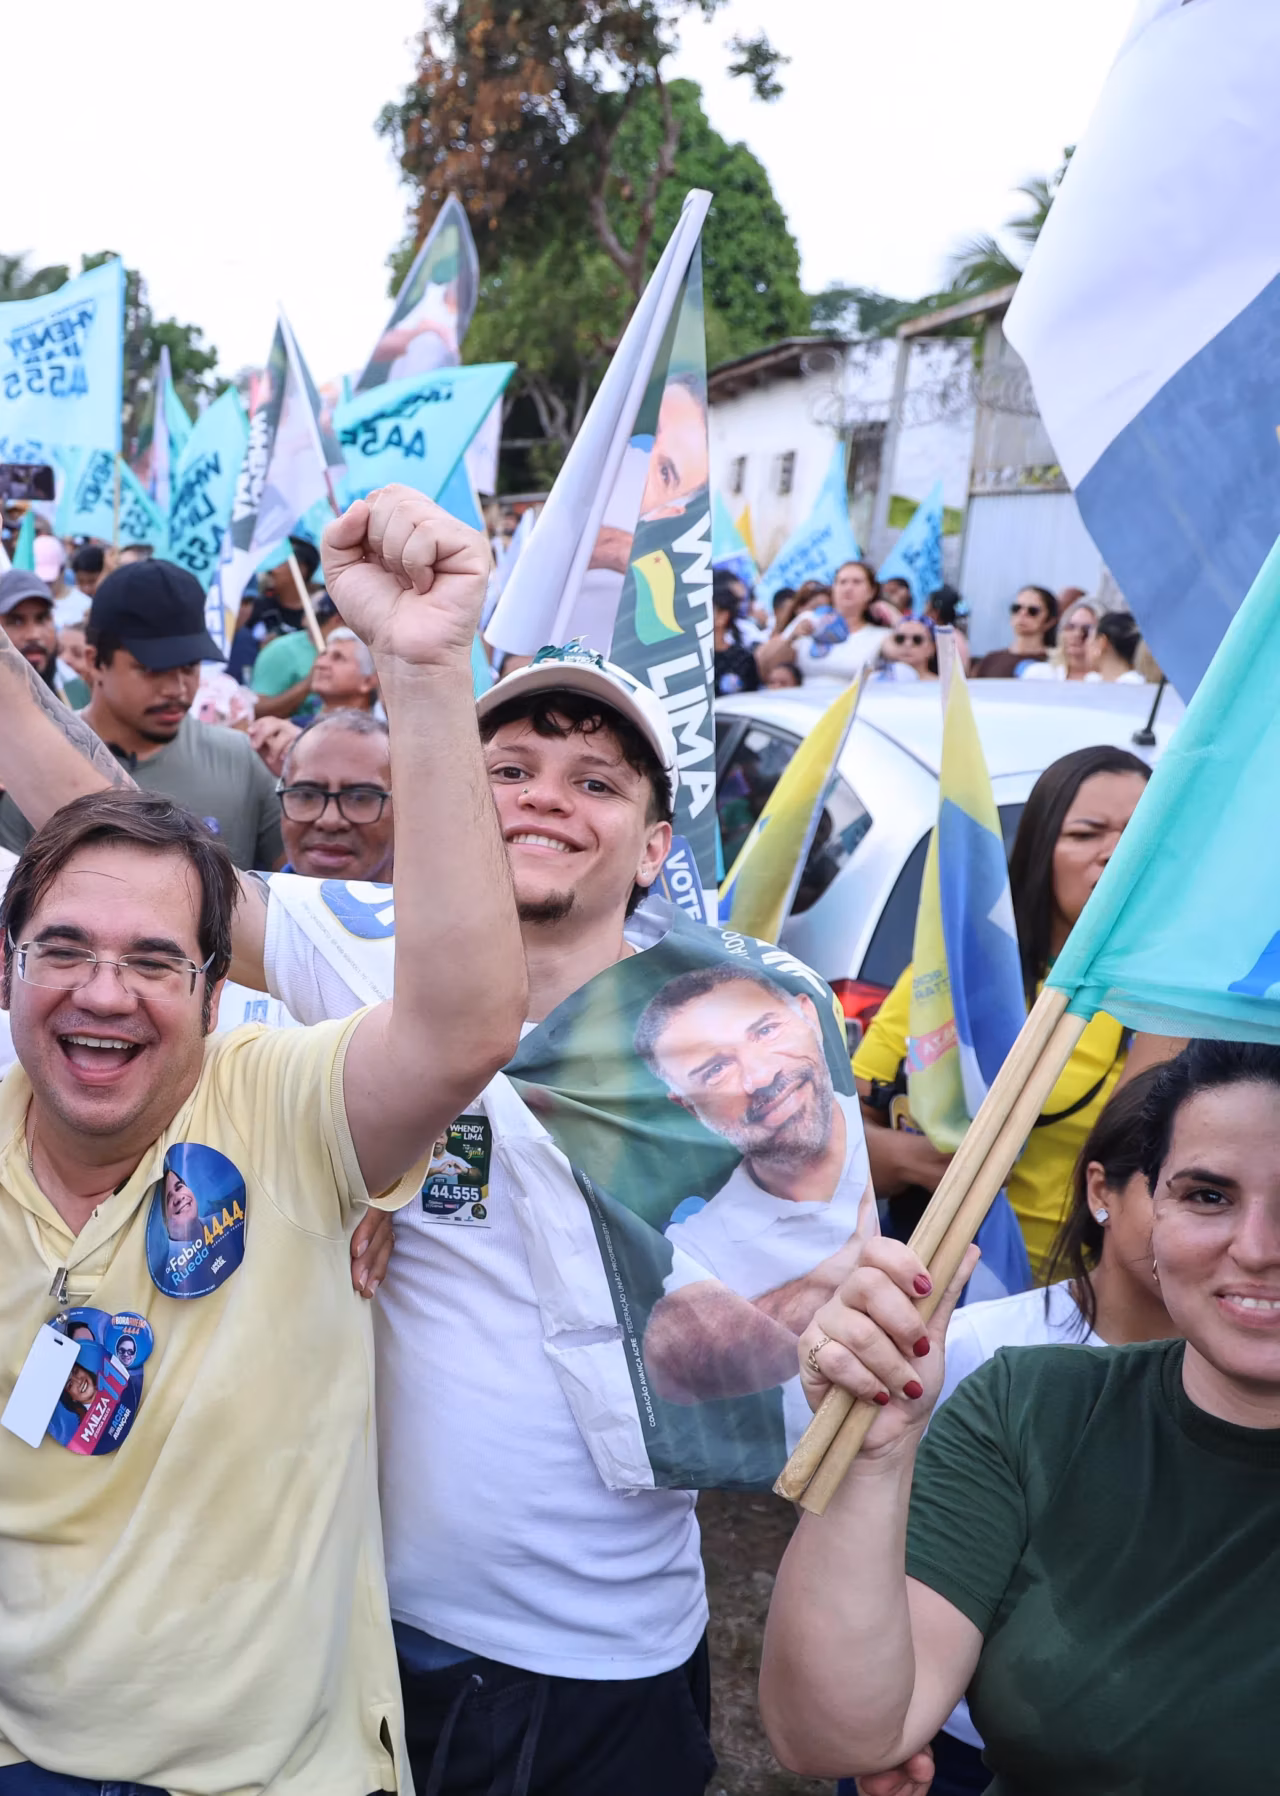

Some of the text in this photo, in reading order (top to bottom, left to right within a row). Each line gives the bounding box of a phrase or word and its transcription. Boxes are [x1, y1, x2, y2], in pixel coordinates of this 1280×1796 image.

[647, 651, 716, 820] LIMA
[449, 1124, 485, 1134] WHENDY
[463, 1133, 484, 1141] LIMA
[429, 1184, 480, 1201] 44.555
[203, 1199, 245, 1246] 4444
[168, 1238, 203, 1273] Fabio
[171, 1247, 210, 1287] Rueda
[620, 1293, 635, 1334] FEDERAÇÃO
[630, 1338, 640, 1357] ACRE
[636, 1357, 648, 1385] AVANÇA
[80, 1396, 111, 1443] MAILZA
[111, 1403, 127, 1429] ACRE
[641, 1385, 656, 1428] COLIGAÇÃO
